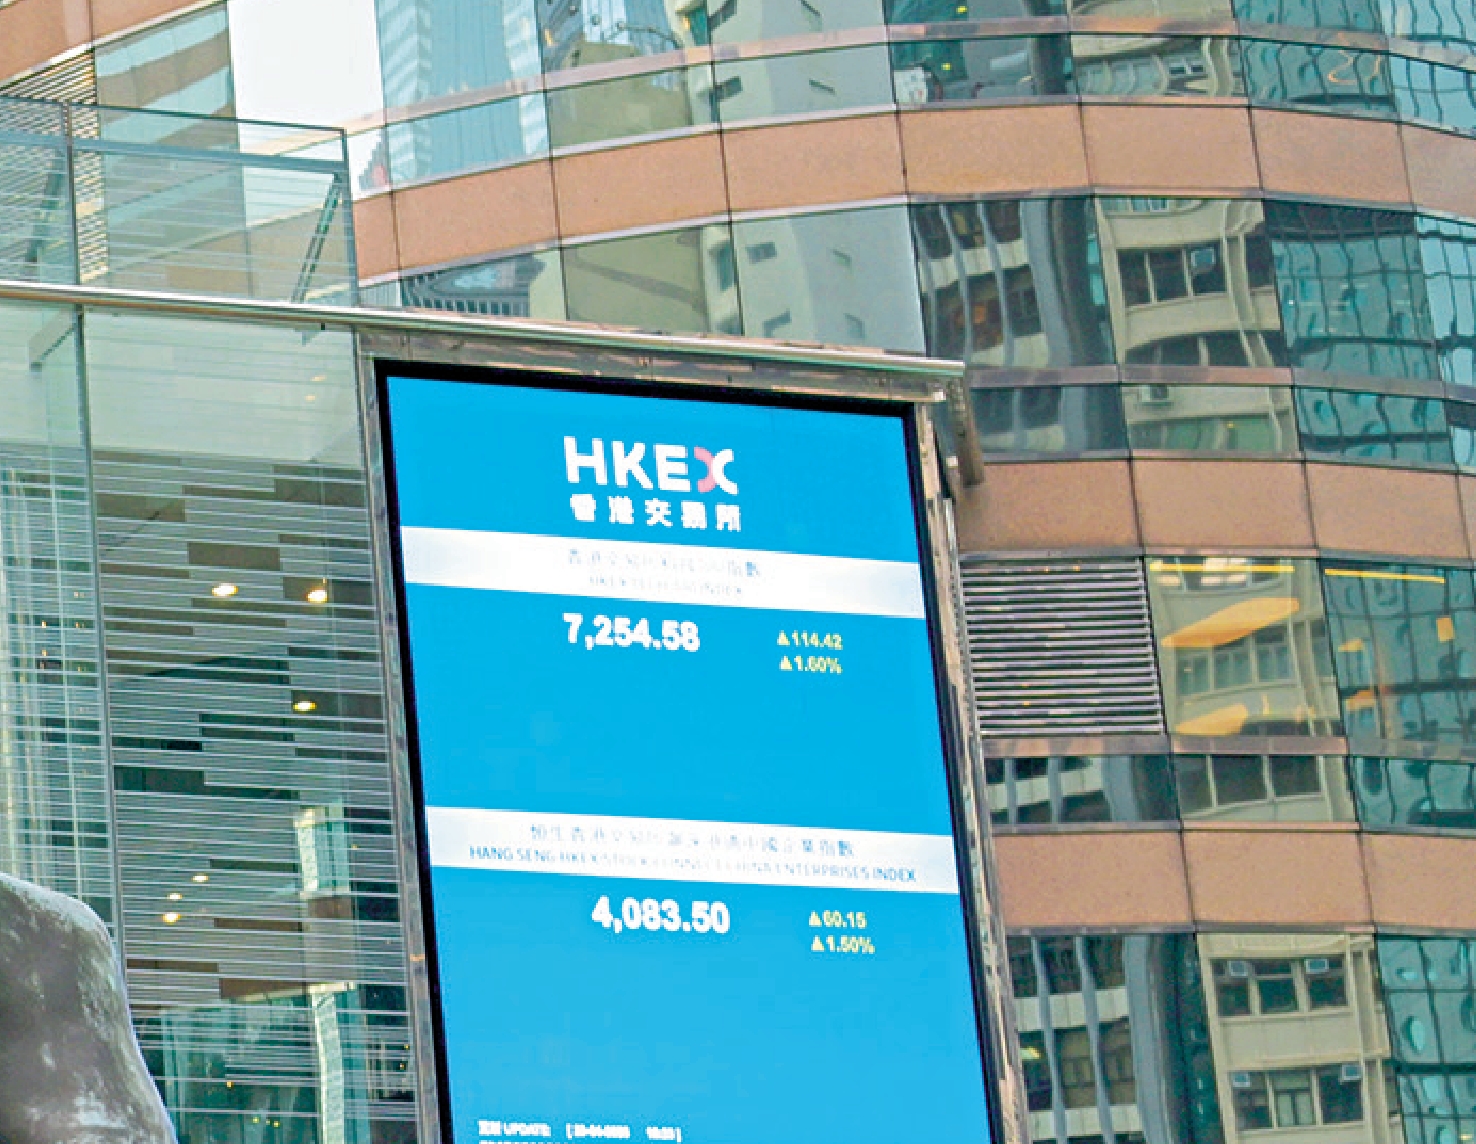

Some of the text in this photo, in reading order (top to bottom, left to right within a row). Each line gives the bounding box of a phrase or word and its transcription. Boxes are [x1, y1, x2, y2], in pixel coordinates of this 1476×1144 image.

[564, 436, 739, 495] HKEX
[564, 613, 700, 652] 7,254.58
[592, 897, 730, 933] 4,083.50
